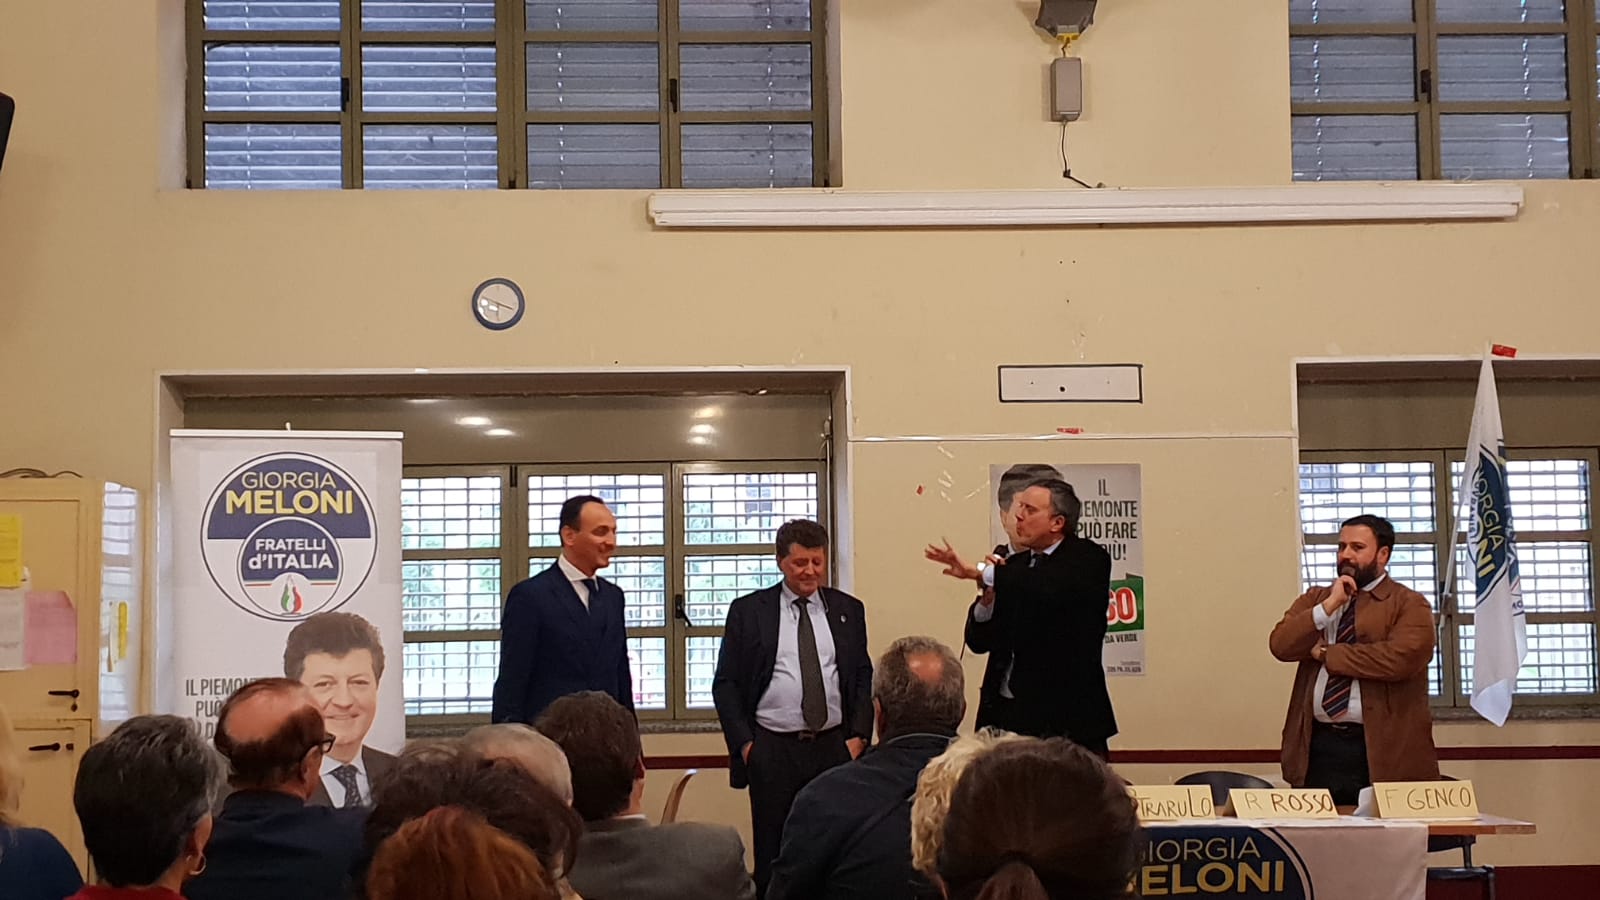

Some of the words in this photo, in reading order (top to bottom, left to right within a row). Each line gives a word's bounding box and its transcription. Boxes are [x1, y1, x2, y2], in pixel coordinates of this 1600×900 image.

[242, 471, 336, 489] GIORGIA
[1098, 479, 1110, 496] IL
[225, 490, 353, 515] MELONI
[1079, 500, 1138, 518] IEMONTE
[1105, 522, 1138, 539] FARE
[255, 538, 327, 551] FRATELLI
[248, 553, 334, 570] d'ITALIA
[186, 679, 198, 696] IL
[1136, 788, 1212, 817] TRARULO
[1271, 793, 1334, 813] ROSSO
[1406, 787, 1472, 810] GENCO
[1145, 836, 1261, 862] IORGIA
[1142, 861, 1284, 896] ELONI
